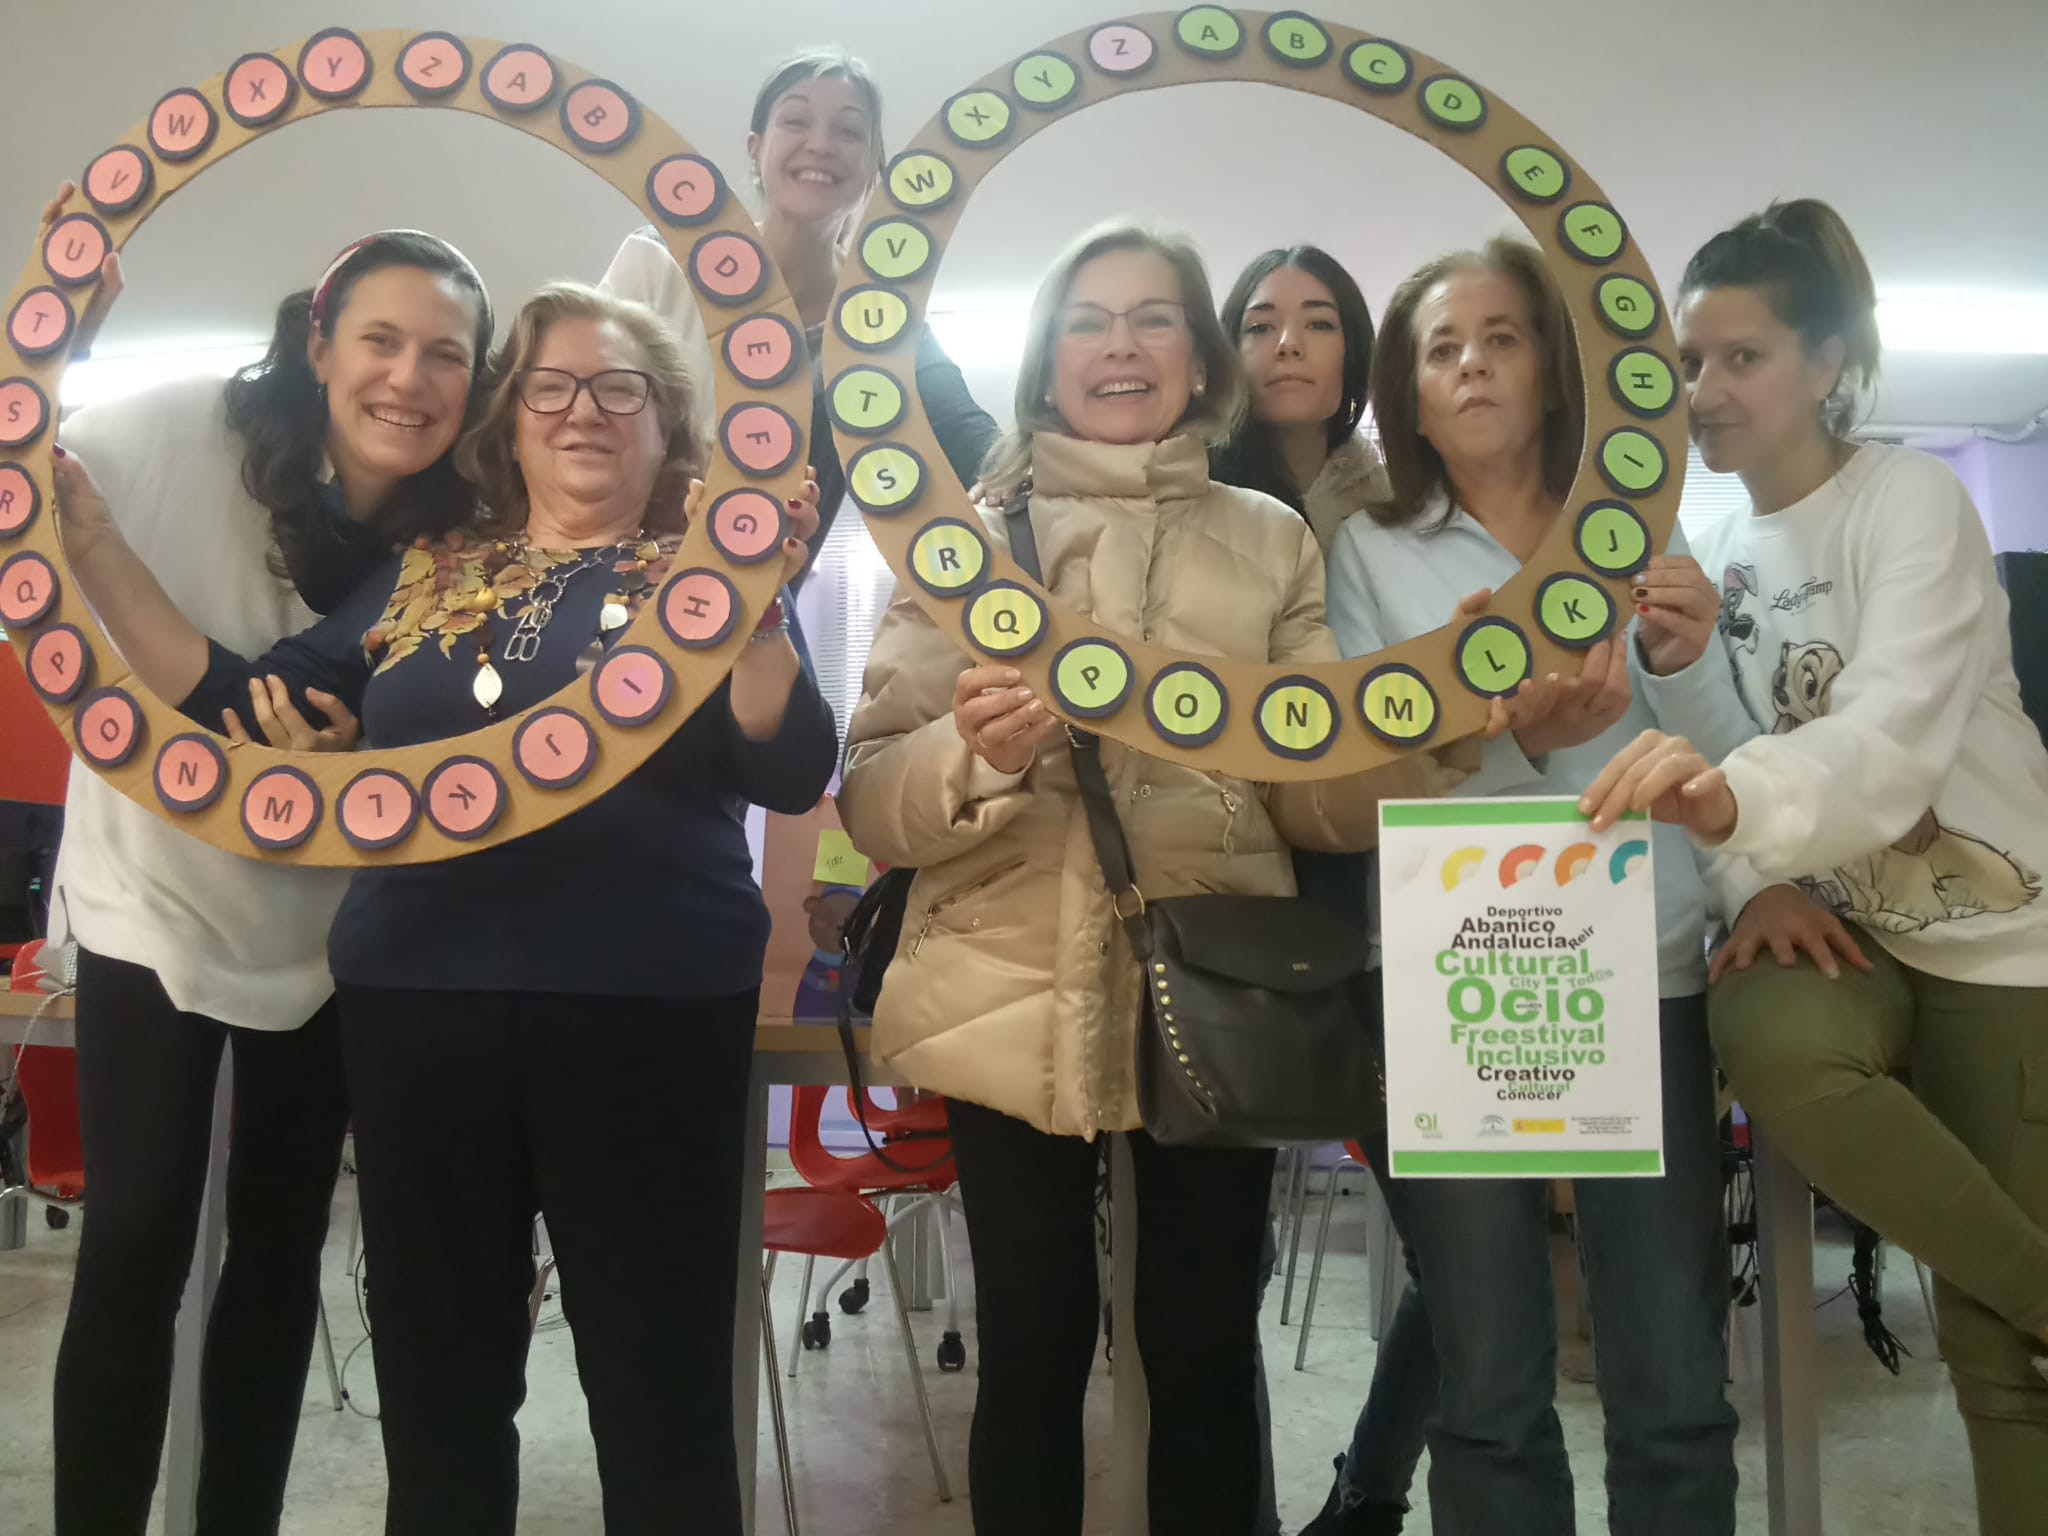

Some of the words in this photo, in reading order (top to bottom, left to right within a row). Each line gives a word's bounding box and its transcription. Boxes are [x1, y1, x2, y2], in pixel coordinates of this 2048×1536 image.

[1200, 25, 1220, 42] A
[1289, 32, 1305, 50] B
[1111, 38, 1129, 56] Z
[326, 56, 343, 78] Y
[420, 56, 442, 77] Z
[1368, 58, 1388, 76] C
[249, 78, 266, 102] X
[506, 71, 527, 93] A
[1033, 70, 1053, 89] Y
[1442, 93, 1462, 111] D
[168, 113, 195, 137] W
[582, 105, 608, 128] B
[964, 105, 991, 127] X
[110, 170, 129, 190] V
[904, 169, 935, 193] W
[1524, 165, 1544, 181] E
[671, 180, 696, 201] C
[1580, 224, 1603, 237] F
[64, 238, 86, 262] U
[886, 237, 907, 259] V
[713, 254, 739, 279] D
[1615, 295, 1637, 312] G
[33, 311, 49, 333] T
[863, 307, 884, 329] U
[746, 341, 772, 358] E
[1630, 372, 1654, 390] H
[8, 400, 22, 422] S
[859, 389, 879, 413] T
[745, 431, 772, 445] F
[1623, 453, 1645, 469] I
[876, 467, 897, 490] S
[0, 488, 16, 515] R
[732, 513, 758, 535] G
[1608, 529, 1619, 553] J
[938, 546, 961, 572] R
[17, 580, 37, 603] Q
[682, 595, 711, 619] H
[1562, 598, 1587, 624] K
[993, 609, 1020, 635] Q
[49, 651, 65, 675] P
[1483, 648, 1508, 674] L
[622, 677, 643, 695] I
[1080, 665, 1101, 691] P
[1174, 692, 1199, 719] O
[1285, 701, 1308, 728] N
[1384, 695, 1416, 722] M
[99, 717, 120, 743] O
[544, 732, 562, 757] J
[177, 761, 198, 787] N
[367, 793, 383, 818] L
[448, 783, 477, 811] K
[263, 796, 295, 824] M
[1487, 906, 1563, 919] Deportivo
[1460, 917, 1555, 933] Abanico
[1435, 949, 1590, 976] Cultural
[1509, 976, 1541, 990] City
[1446, 977, 1605, 1023] Ocio
[1450, 1023, 1605, 1045] Freestival
[1466, 1045, 1606, 1066] Inclusivo
[1477, 1065, 1576, 1082] Creativo
[1496, 1089, 1563, 1100] Conocer
